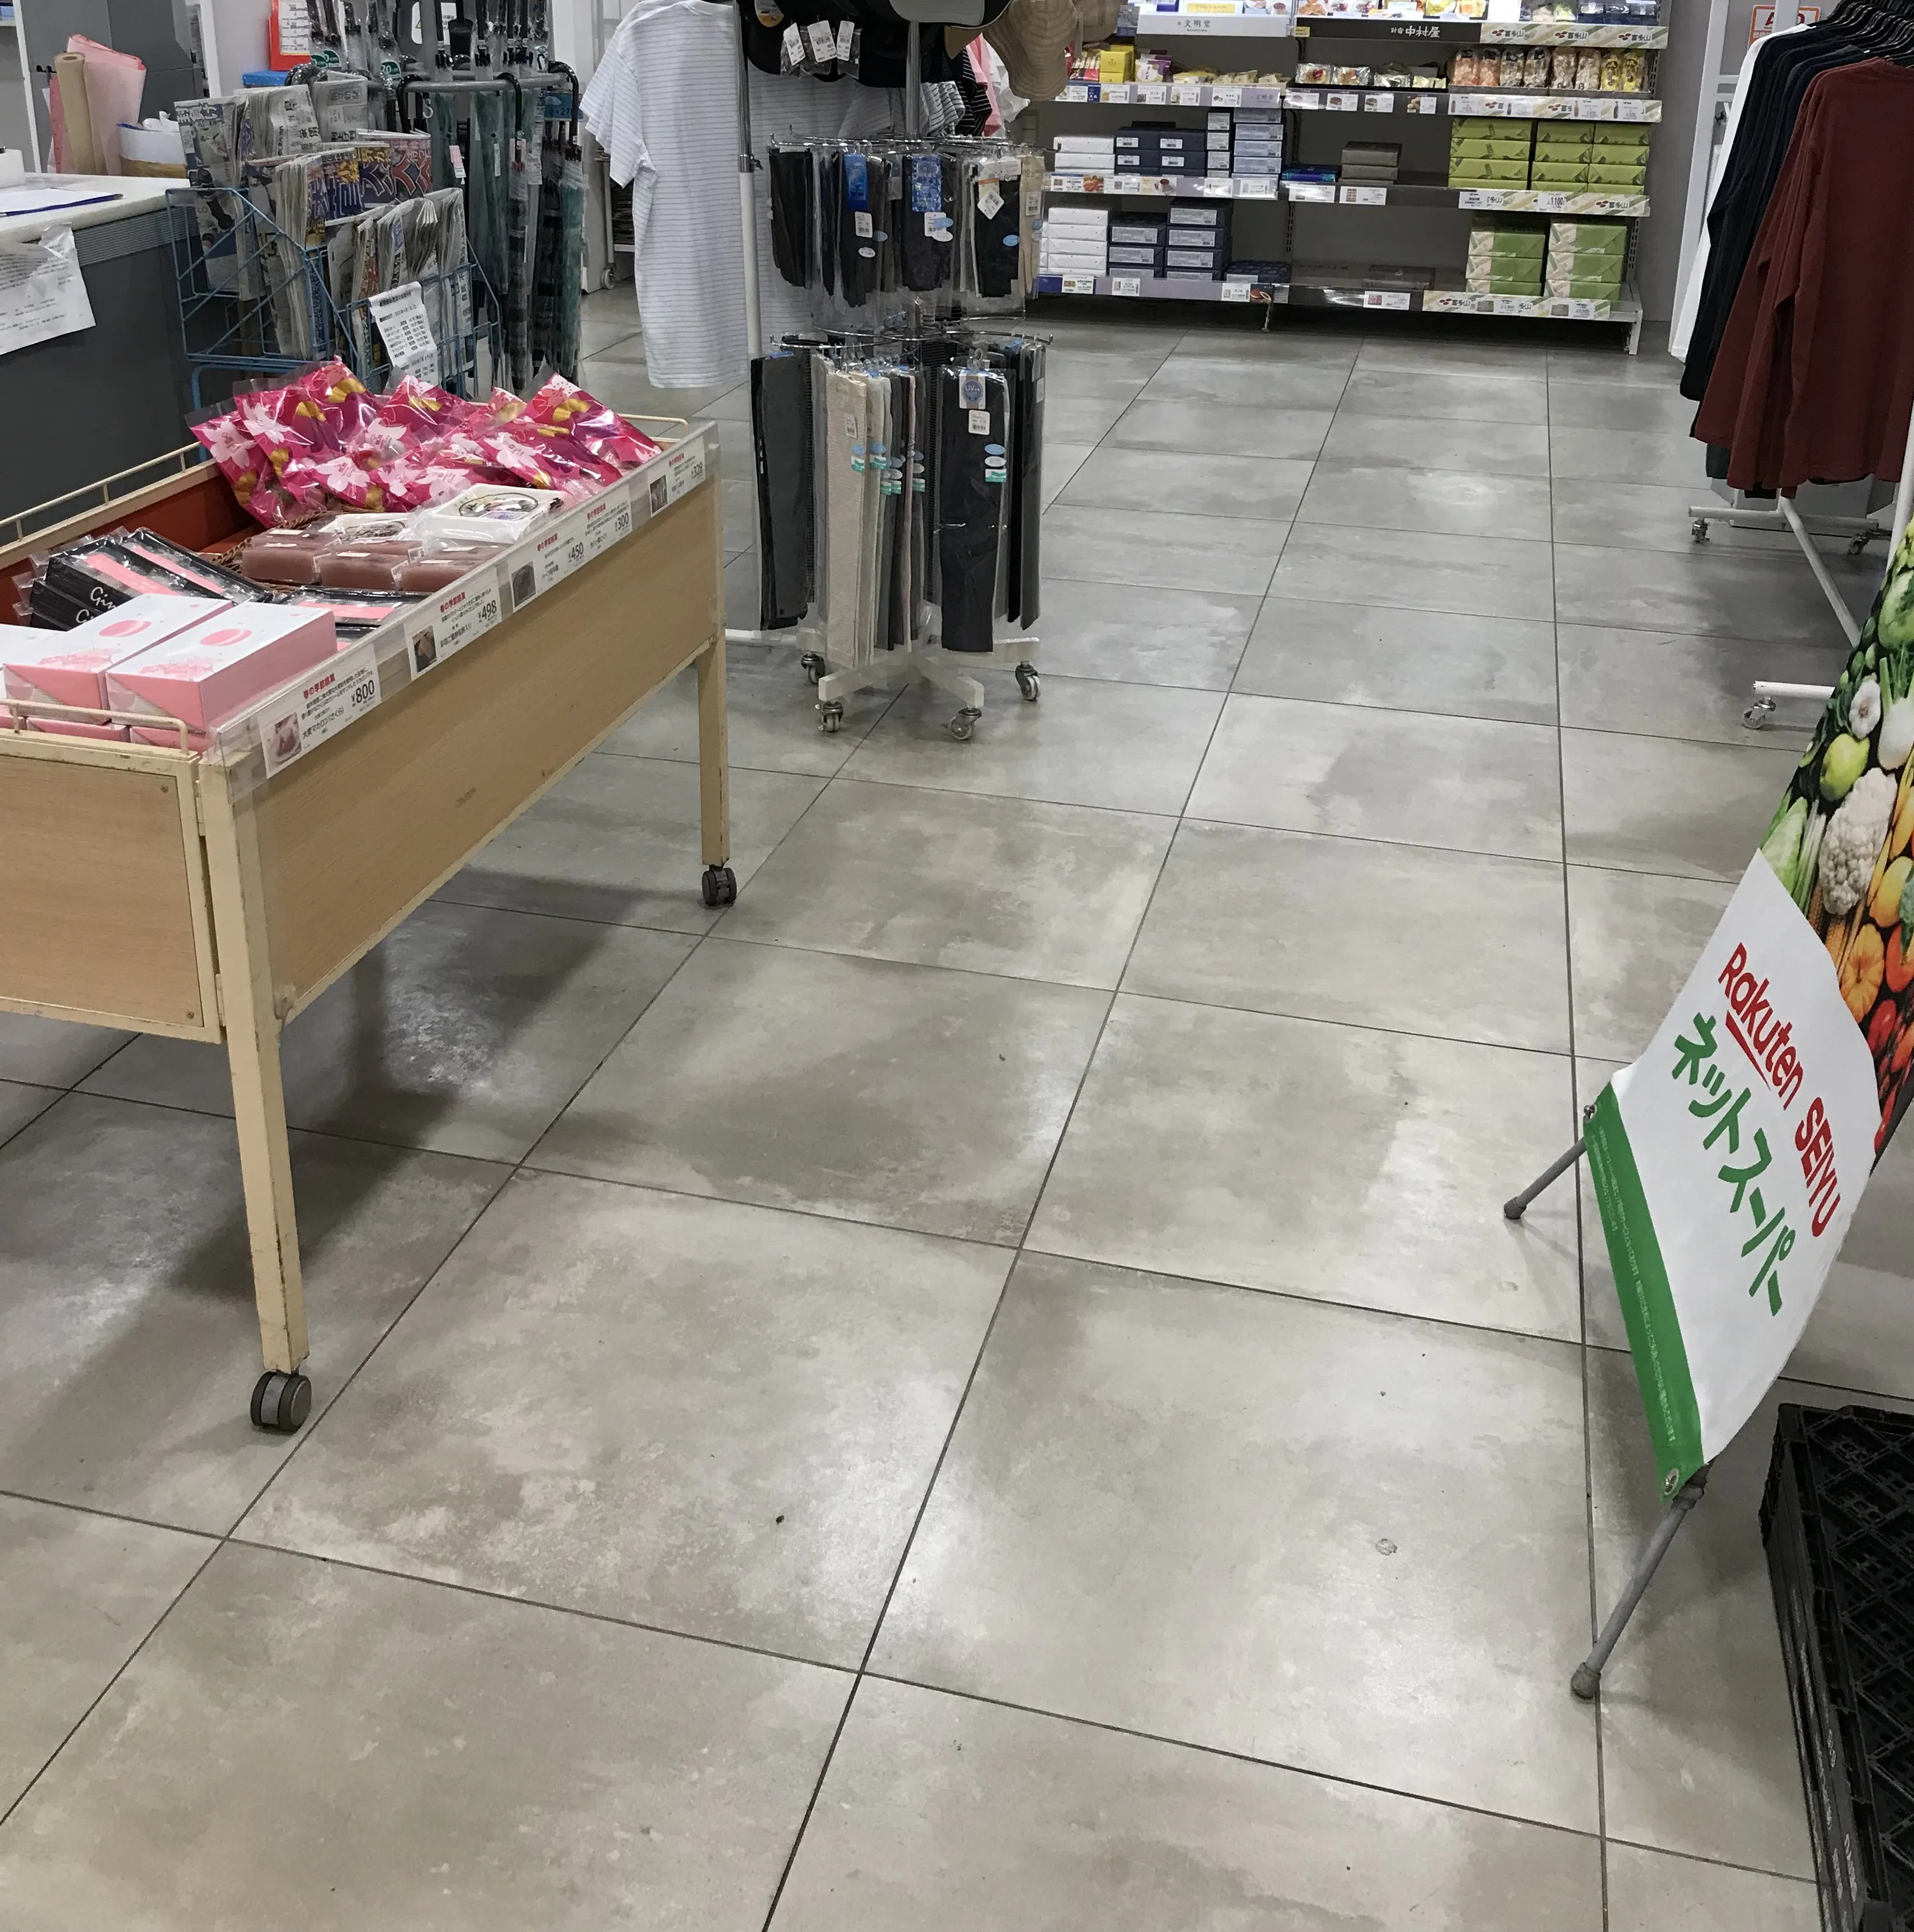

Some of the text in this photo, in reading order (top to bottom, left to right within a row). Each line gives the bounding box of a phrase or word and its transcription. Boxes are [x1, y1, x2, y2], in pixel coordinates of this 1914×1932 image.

[1184, 20, 1210, 28] 文明堂
[568, 542, 584, 560] ¥450
[478, 600, 497, 620] ¥498
[351, 679, 375, 704] ¥800
[1717, 942, 1841, 1237] Rakuten SEIYU
[1672, 1011, 1796, 1317] ネットスーパー
